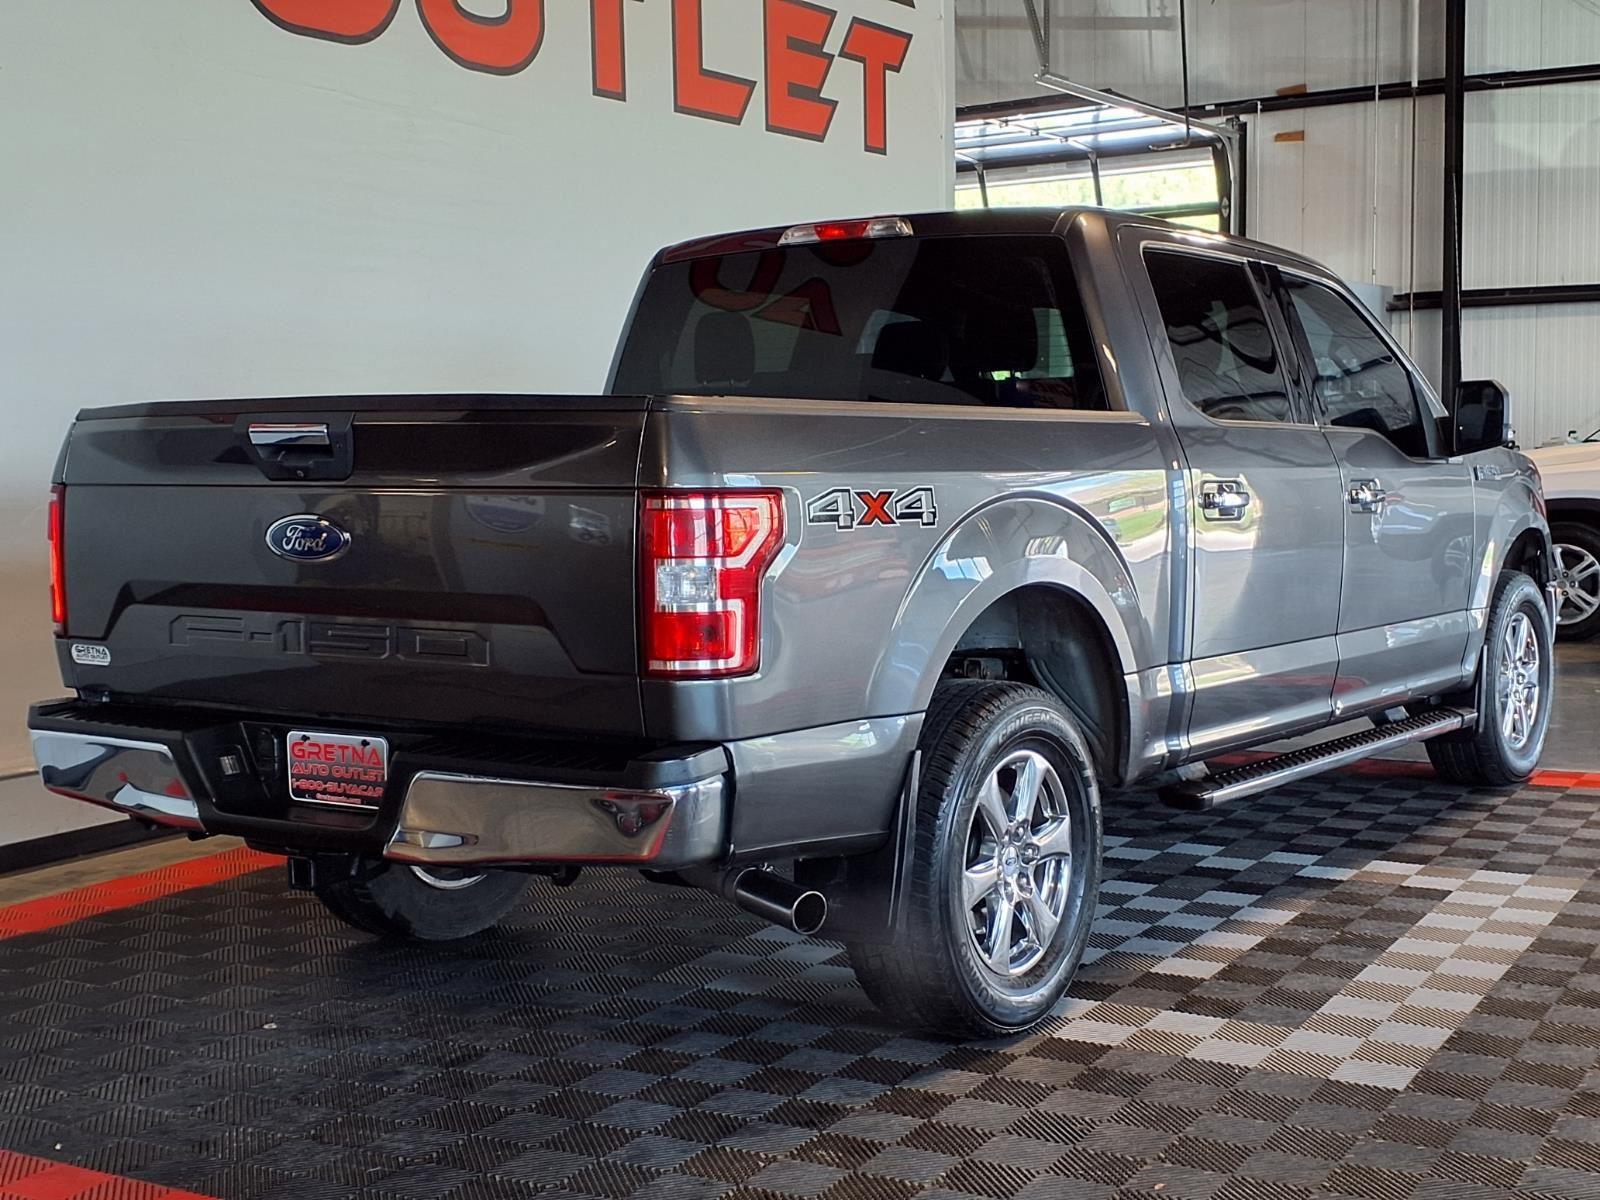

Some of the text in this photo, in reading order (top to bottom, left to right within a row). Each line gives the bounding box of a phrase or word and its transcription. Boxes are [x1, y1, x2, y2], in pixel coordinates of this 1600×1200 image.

[248, 0, 913, 156] TLET
[282, 524, 328, 551] Ford
[169, 613, 490, 667] F-150
[291, 742, 382, 766] GRETNA
[292, 762, 385, 782] AUTO OUTLET
